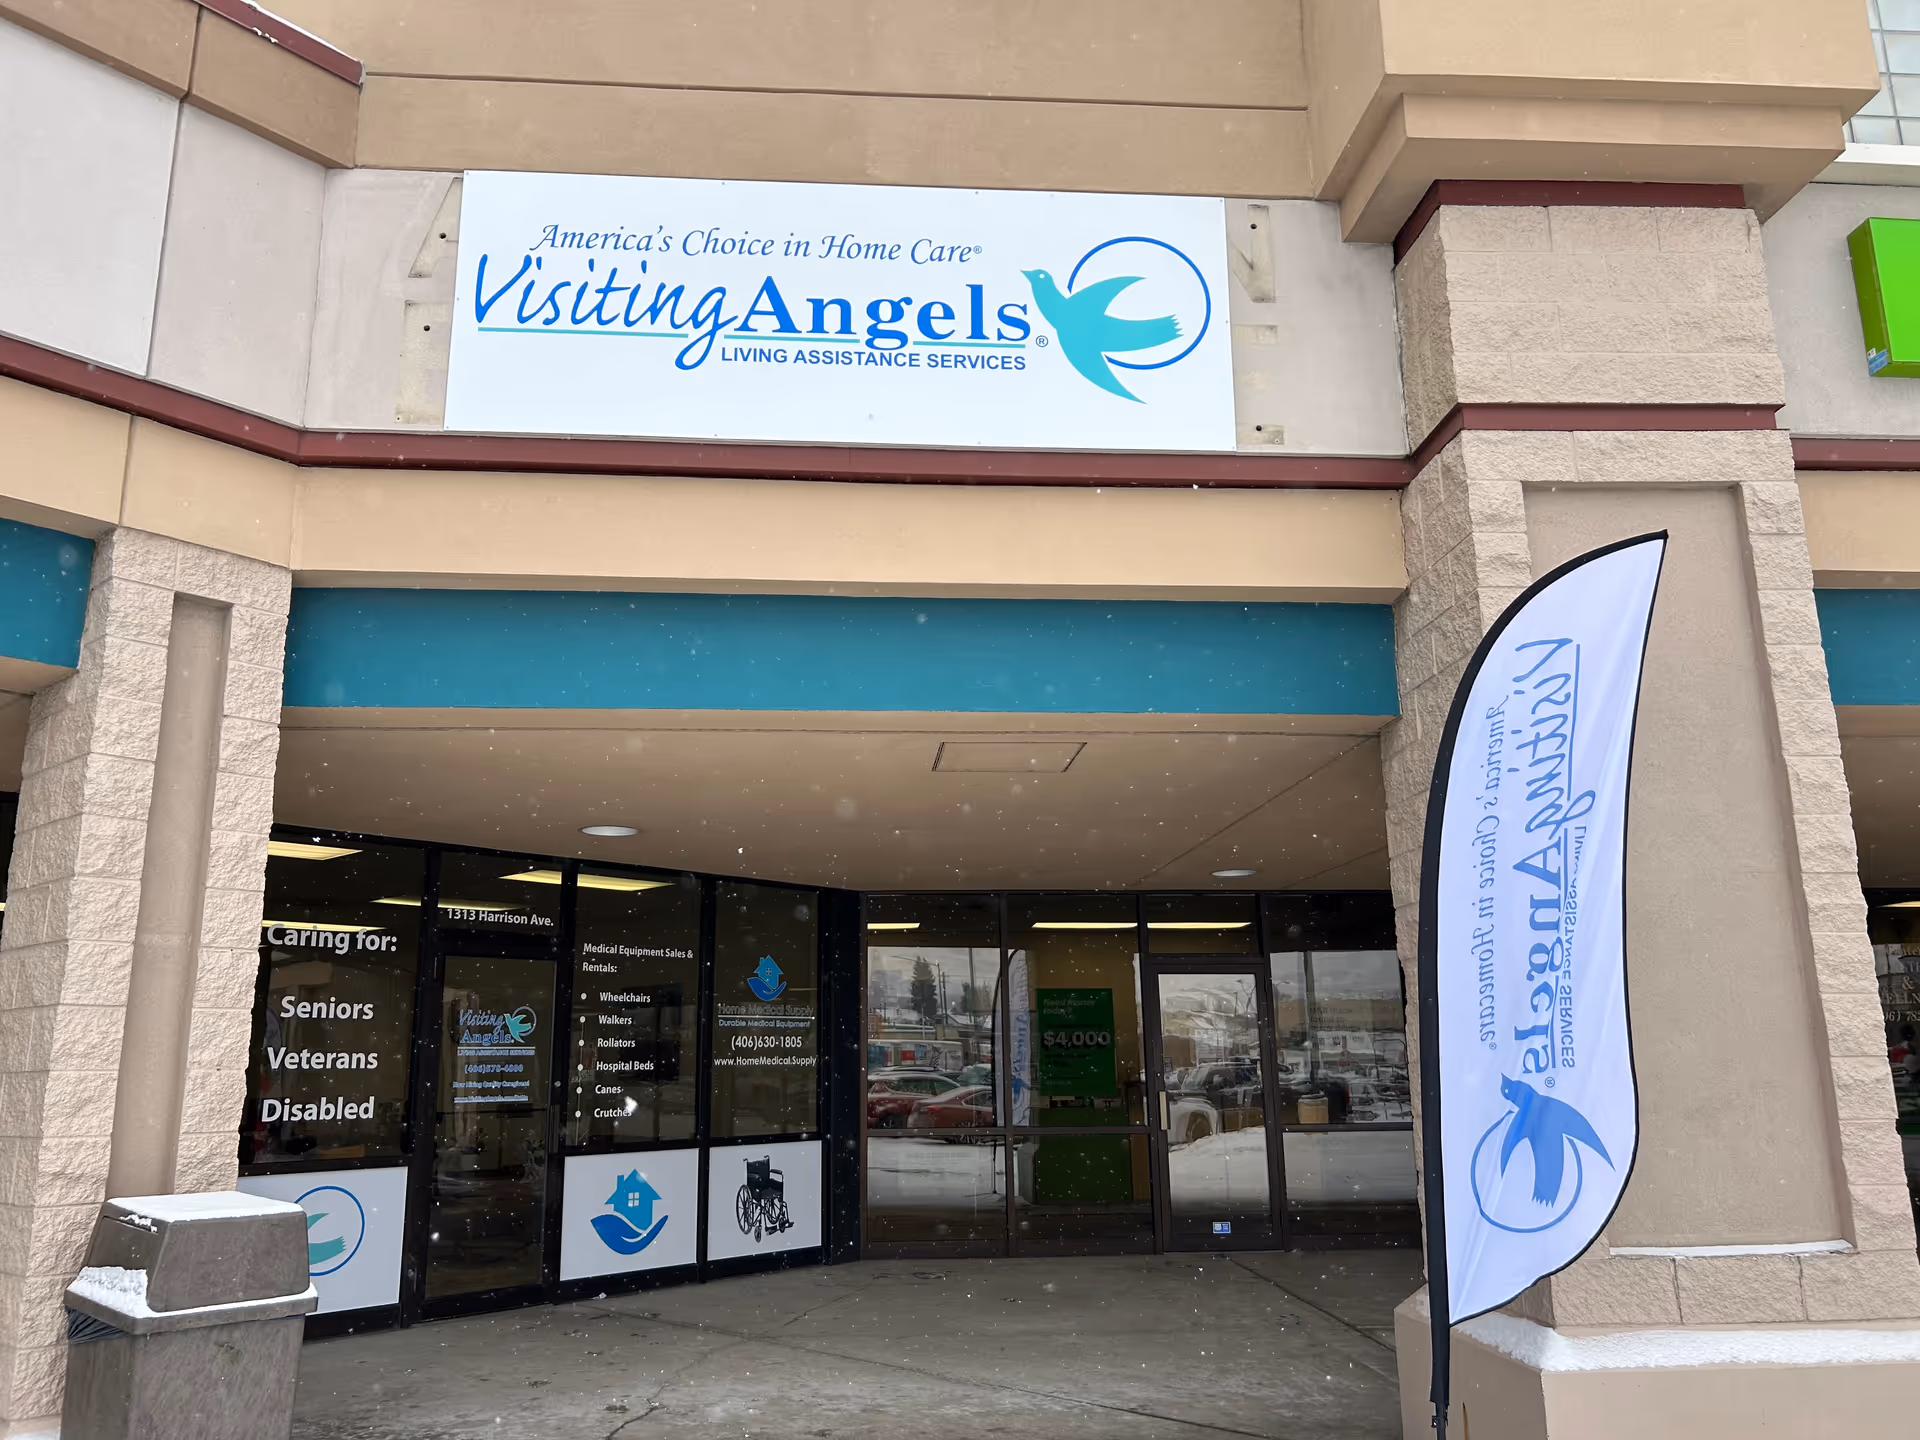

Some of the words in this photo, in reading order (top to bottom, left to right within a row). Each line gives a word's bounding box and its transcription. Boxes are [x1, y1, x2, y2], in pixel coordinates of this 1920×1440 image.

[529, 222, 672, 254] America's
[681, 228, 776, 259] Choice
[784, 231, 812, 258] in
[818, 233, 903, 263] Home
[474, 253, 738, 370] Visiting
[737, 276, 1031, 353] Angels
[721, 346, 789, 364] LIVING
[793, 348, 921, 368] ASSISTANCE
[927, 353, 1026, 370] SERVICES
[446, 908, 476, 921] 1313
[478, 910, 528, 925] Harrison
[530, 913, 554, 926] Ave.
[267, 923, 350, 955] Caring
[355, 929, 398, 951] for:
[583, 943, 618, 955] Medical
[619, 945, 664, 958] Equipment
[665, 949, 686, 958] Sales
[686, 950, 694, 959] &
[582, 962, 618, 973] Rentals:
[1902, 976, 1915, 990] &
[599, 992, 651, 1003] Wheelchairs
[280, 996, 374, 1020] Seniors
[718, 1003, 747, 1015] Home
[748, 1004, 784, 1015] Medical
[785, 1005, 814, 1017] Supply
[459, 1009, 505, 1035] Visiting
[598, 1015, 633, 1025] Walkers
[718, 1019, 746, 1027] Durable
[747, 1019, 775, 1027] Medical
[776, 1020, 811, 1029] Equipment
[597, 1038, 636, 1048] Rollators
[731, 1036, 802, 1050] (406)630-1805
[1043, 1031, 1111, 1048] $4,000
[267, 1046, 378, 1070] Veterans
[714, 1056, 817, 1067] www.HomeMedical.Supply
[596, 1061, 632, 1073] Hospital
[634, 1061, 654, 1071] Beds
[595, 1085, 622, 1094] Canes
[261, 1096, 375, 1122] Disabled
[594, 1108, 632, 1118] Crutches
